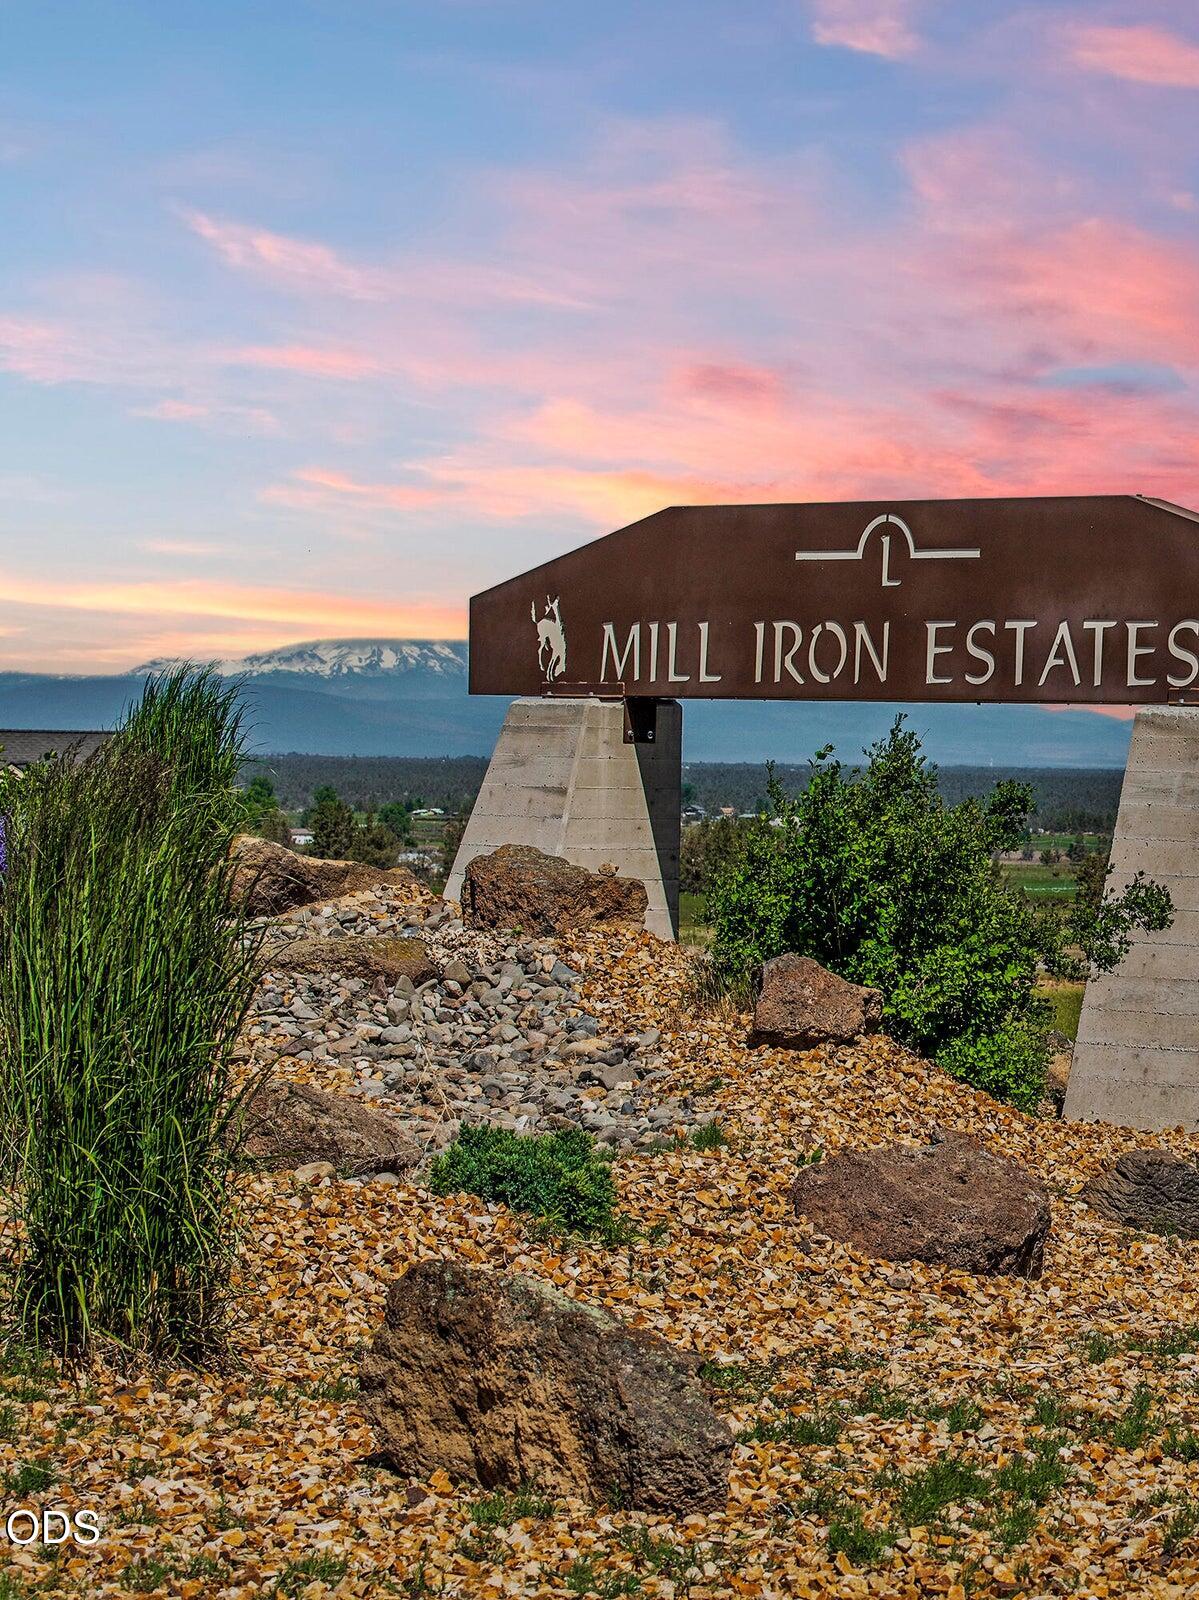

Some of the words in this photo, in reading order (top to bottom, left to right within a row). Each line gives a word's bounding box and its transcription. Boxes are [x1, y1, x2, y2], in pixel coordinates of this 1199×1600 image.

[600, 621, 722, 683] MILL
[754, 620, 890, 684] IRON
[924, 619, 1199, 687] ESTATES
